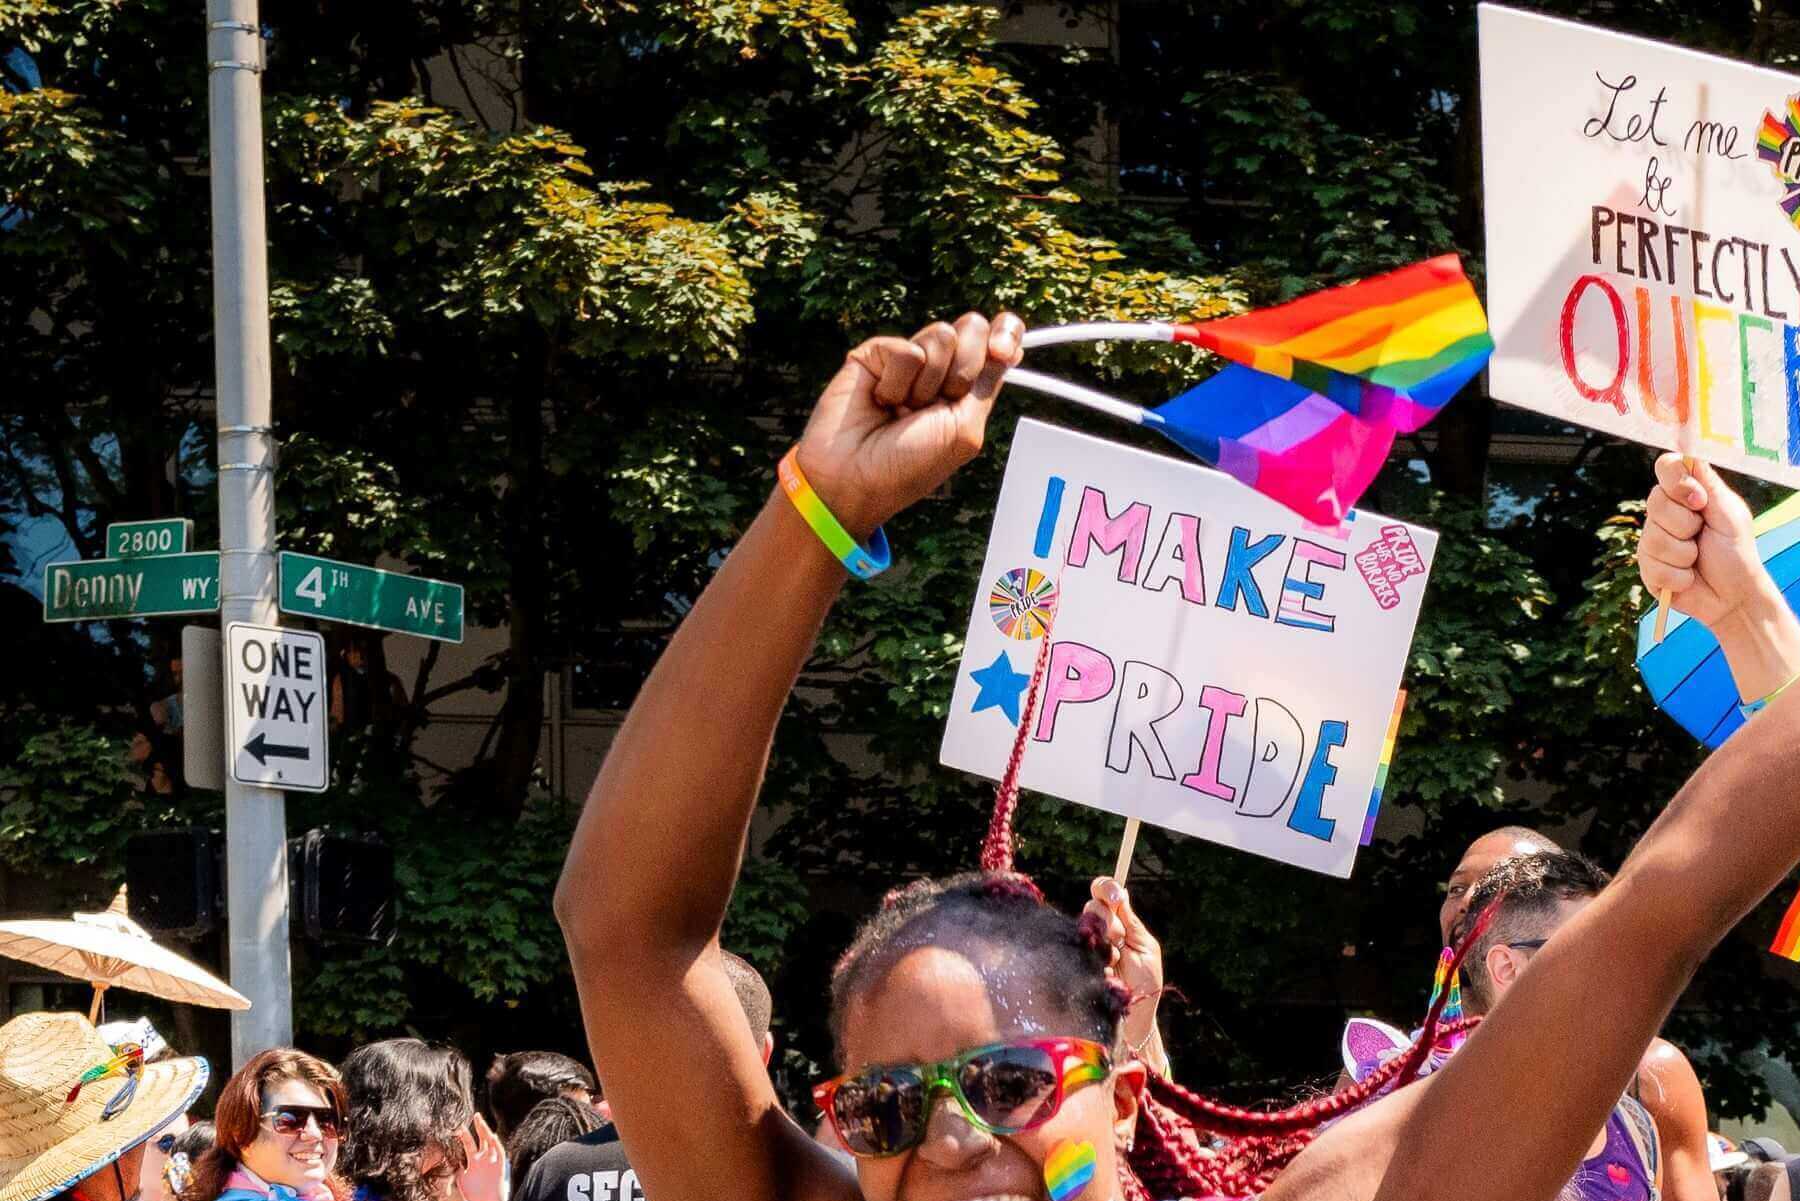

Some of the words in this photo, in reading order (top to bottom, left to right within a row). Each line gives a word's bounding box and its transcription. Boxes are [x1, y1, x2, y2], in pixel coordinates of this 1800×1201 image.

[1583, 71, 1667, 146] Let
[1684, 116, 1749, 160] me
[1639, 156, 1677, 216] be
[118, 528, 173, 553] 2800
[1032, 475, 1066, 559] I
[1066, 485, 1347, 632] MAKE
[1383, 526, 1424, 575] PRIDE
[53, 567, 144, 609] Denny
[182, 578, 210, 600] WY
[1355, 552, 1400, 607] BORDERS
[1383, 563, 1402, 582] NO
[405, 595, 445, 625] AVE
[1010, 591, 1039, 618] PRIDE
[241, 639, 313, 681] ONE
[241, 682, 317, 725] WAY
[1033, 640, 1348, 843] PRIDE
